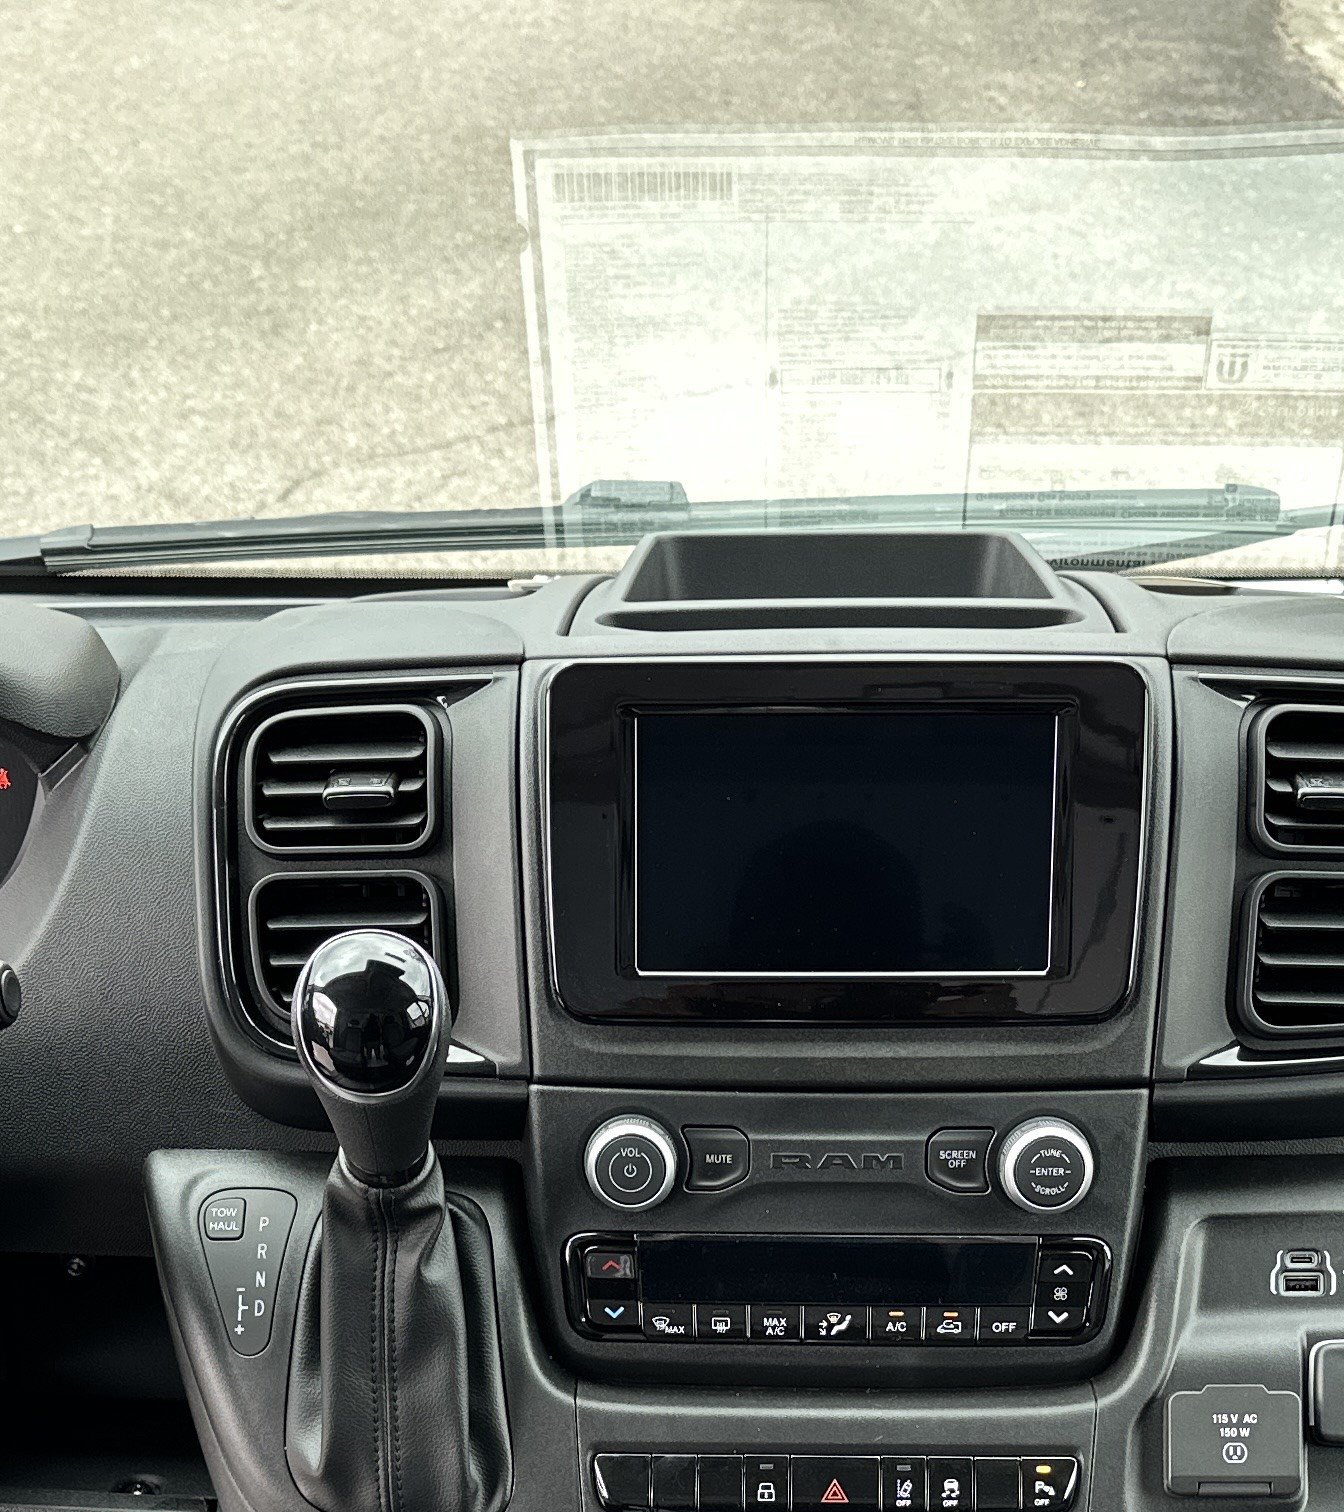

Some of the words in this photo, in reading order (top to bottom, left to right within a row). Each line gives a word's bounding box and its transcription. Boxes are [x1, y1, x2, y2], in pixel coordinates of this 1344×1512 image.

[620, 1147, 641, 1158] VOL
[939, 1149, 977, 1160] SCREEN
[1039, 1148, 1063, 1159] TUNE
[705, 1153, 733, 1164] MUTE
[770, 1152, 905, 1170] RAM
[947, 1159, 967, 1169] OFF
[1035, 1167, 1064, 1177] ENTER
[1034, 1185, 1066, 1196] SCROLL
[211, 1207, 238, 1218] TOW
[209, 1221, 240, 1231] HAUL
[259, 1217, 269, 1231] P
[257, 1243, 267, 1259] R
[256, 1271, 266, 1288] N
[254, 1299, 265, 1317] D
[763, 1317, 788, 1327] MAX
[885, 1322, 907, 1332] A/C
[991, 1322, 1017, 1333] OFF
[664, 1325, 685, 1334] MAX
[765, 1326, 785, 1336] A/C
[1212, 1413, 1229, 1424] 115
[1230, 1413, 1239, 1424] V
[1243, 1413, 1258, 1424] AC
[1219, 1427, 1237, 1437] 150
[1239, 1427, 1250, 1437] W
[895, 1499, 912, 1507] OFF
[942, 1499, 959, 1507] OFF
[1034, 1498, 1050, 1506] OFF
